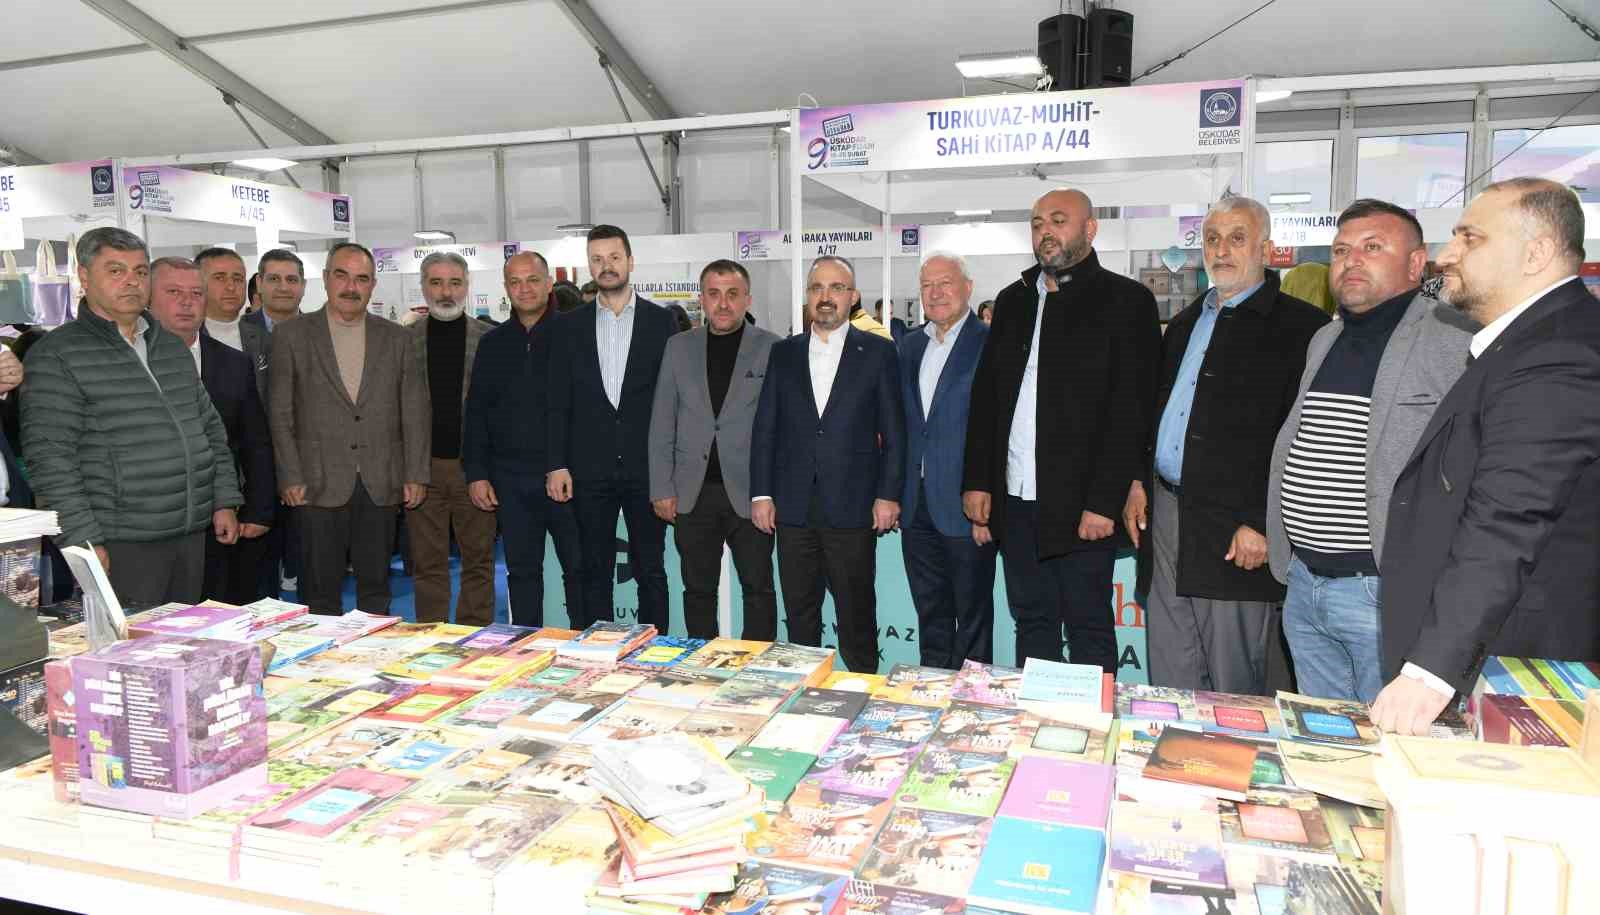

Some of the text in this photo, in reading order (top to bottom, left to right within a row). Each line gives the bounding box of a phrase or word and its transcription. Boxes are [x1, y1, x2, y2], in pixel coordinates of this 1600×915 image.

[927, 100, 1101, 131] TURKUVAZ-MUHİT-
[937, 128, 1091, 157] SAHİ KİTAP A/44
[231, 183, 271, 204] KETEBE
[240, 205, 266, 222] A/45
[1281, 215, 1337, 228] YAYINLARI
[829, 231, 873, 241] YAYINLARI
[817, 244, 838, 255] A/17
